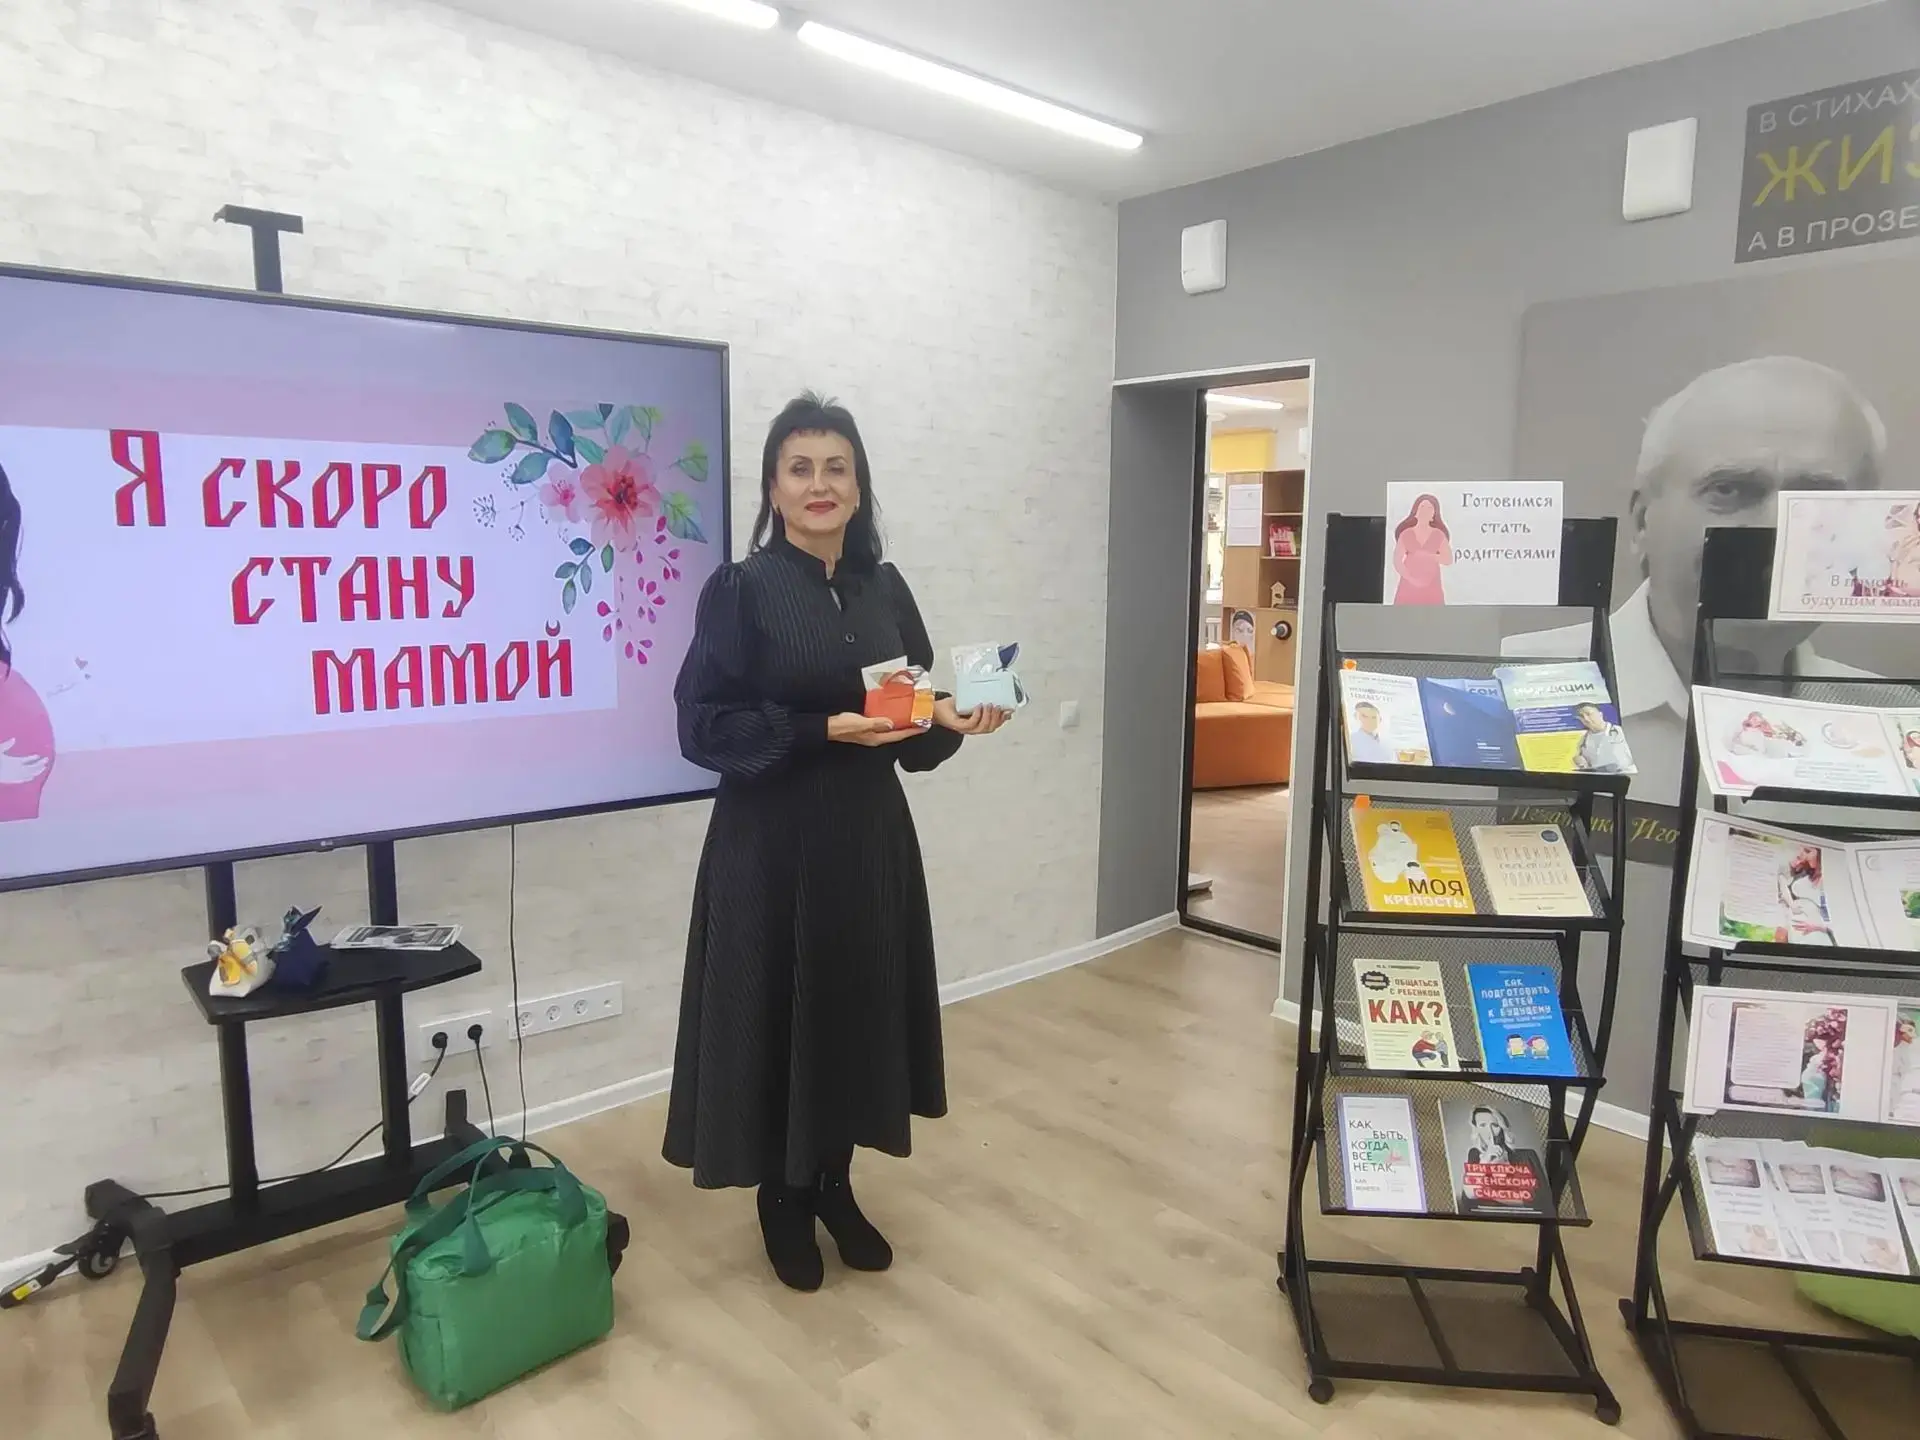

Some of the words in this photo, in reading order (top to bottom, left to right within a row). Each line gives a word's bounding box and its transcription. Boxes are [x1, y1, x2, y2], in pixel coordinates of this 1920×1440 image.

[1759, 111, 1777, 134] В
[1788, 78, 1920, 127] СТИХАХ
[1748, 231, 1767, 253] А
[1777, 225, 1795, 249] В
[109, 429, 167, 527] Я
[202, 458, 448, 530] СКОРО
[1462, 492, 1553, 508] Готовимся
[1480, 522, 1532, 534] стать
[1454, 548, 1556, 564] родителями
[1831, 575, 1840, 587] В
[231, 555, 476, 625] СТАНУ
[311, 619, 574, 715] МАМОЙ
[1408, 878, 1465, 896] МОЯ
[1394, 979, 1439, 988] ОБЩАТЬСЯ
[1504, 978, 1523, 987] КАК
[1481, 986, 1550, 999] ПОДГОТОВИТЬ
[1502, 996, 1533, 1008] ДЕТЕЙ
[1367, 998, 1444, 1026] КАК?
[1487, 1009, 1495, 1018] К
[1348, 1120, 1373, 1129] КАК
[1351, 1141, 1390, 1151] КОГДА
[1352, 1151, 1373, 1161] ВСЕ
[1353, 1162, 1369, 1172] НЕ
[1466, 1163, 1487, 1173] ТРИ
[1490, 1164, 1531, 1174] КЛЮЧА
[1475, 1177, 1537, 1187] ЖЕНСКОМУ
[1475, 1189, 1532, 1200] СЧАСТЬЮ
